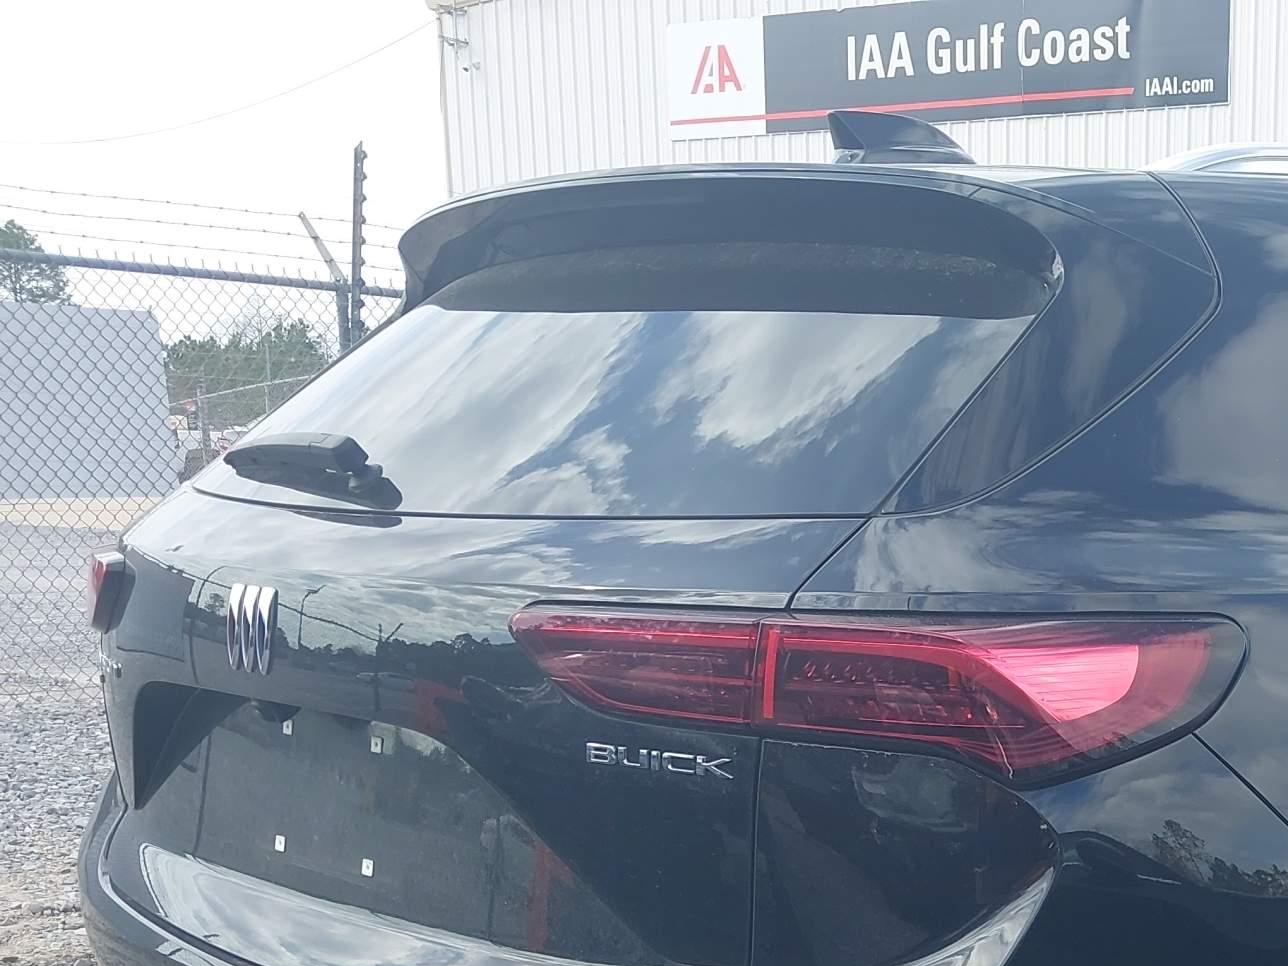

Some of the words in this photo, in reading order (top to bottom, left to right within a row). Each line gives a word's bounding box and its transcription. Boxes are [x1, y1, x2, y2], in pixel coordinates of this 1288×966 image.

[846, 35, 915, 81] IAA
[926, 21, 1005, 75] Gulf
[1017, 16, 1131, 68] Coast
[1145, 76, 1214, 97] IAAI.com
[585, 742, 735, 780] BUICK
